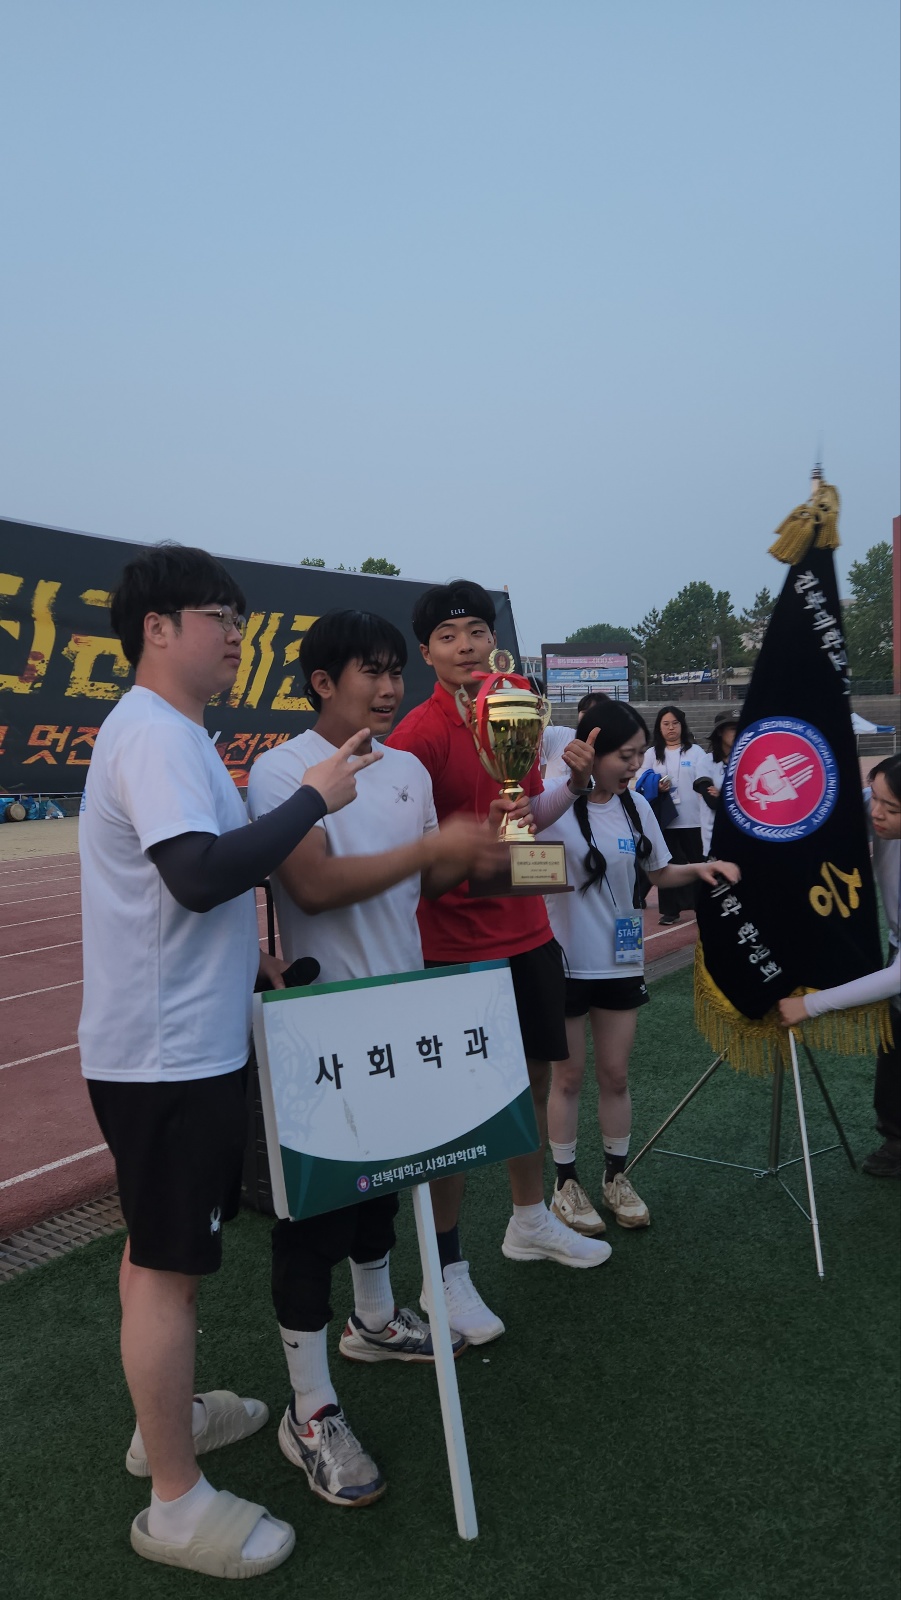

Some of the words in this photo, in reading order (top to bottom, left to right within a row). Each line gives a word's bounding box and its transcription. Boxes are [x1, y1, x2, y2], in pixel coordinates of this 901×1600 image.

[617, 927, 640, 938] STAFF
[737, 921, 783, 983] 학생회
[371, 1161, 424, 1188] 전북대학교
[424, 1143, 488, 1173] 사회과학대학
